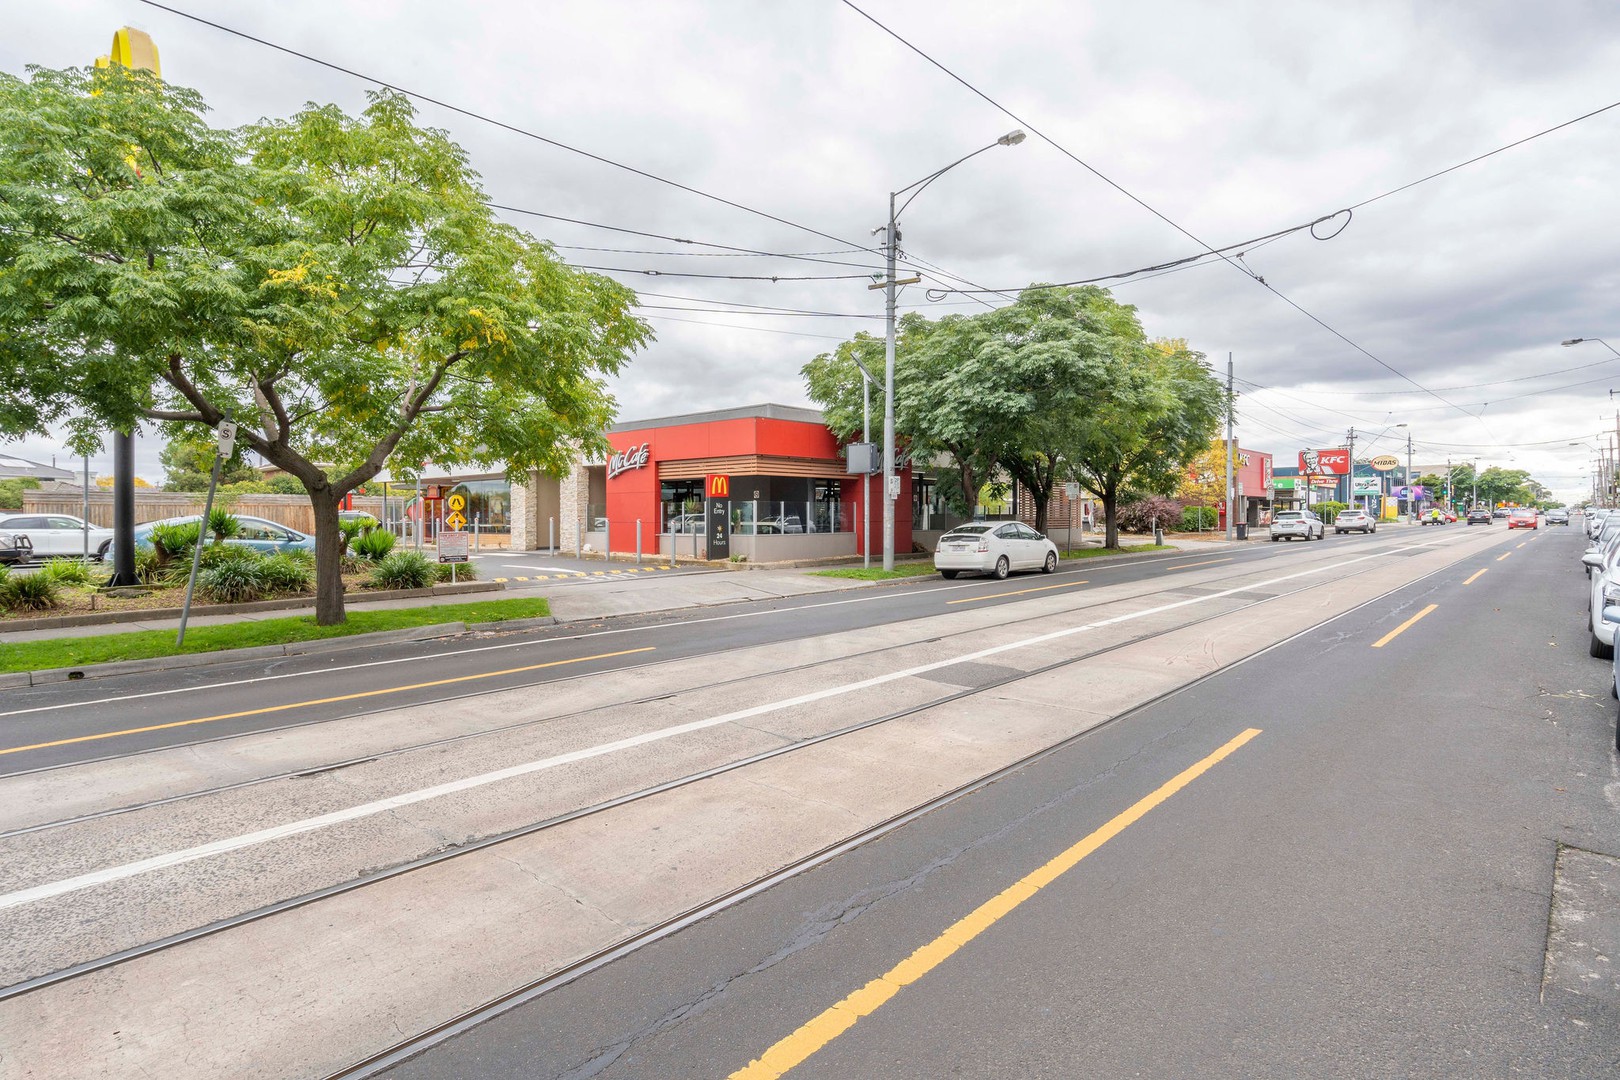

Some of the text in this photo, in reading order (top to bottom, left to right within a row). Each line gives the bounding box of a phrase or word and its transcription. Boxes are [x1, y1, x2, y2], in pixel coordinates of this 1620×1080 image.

[222, 429, 229, 438] S
[1319, 456, 1345, 464] KFC
[713, 508, 725, 516] Entry
